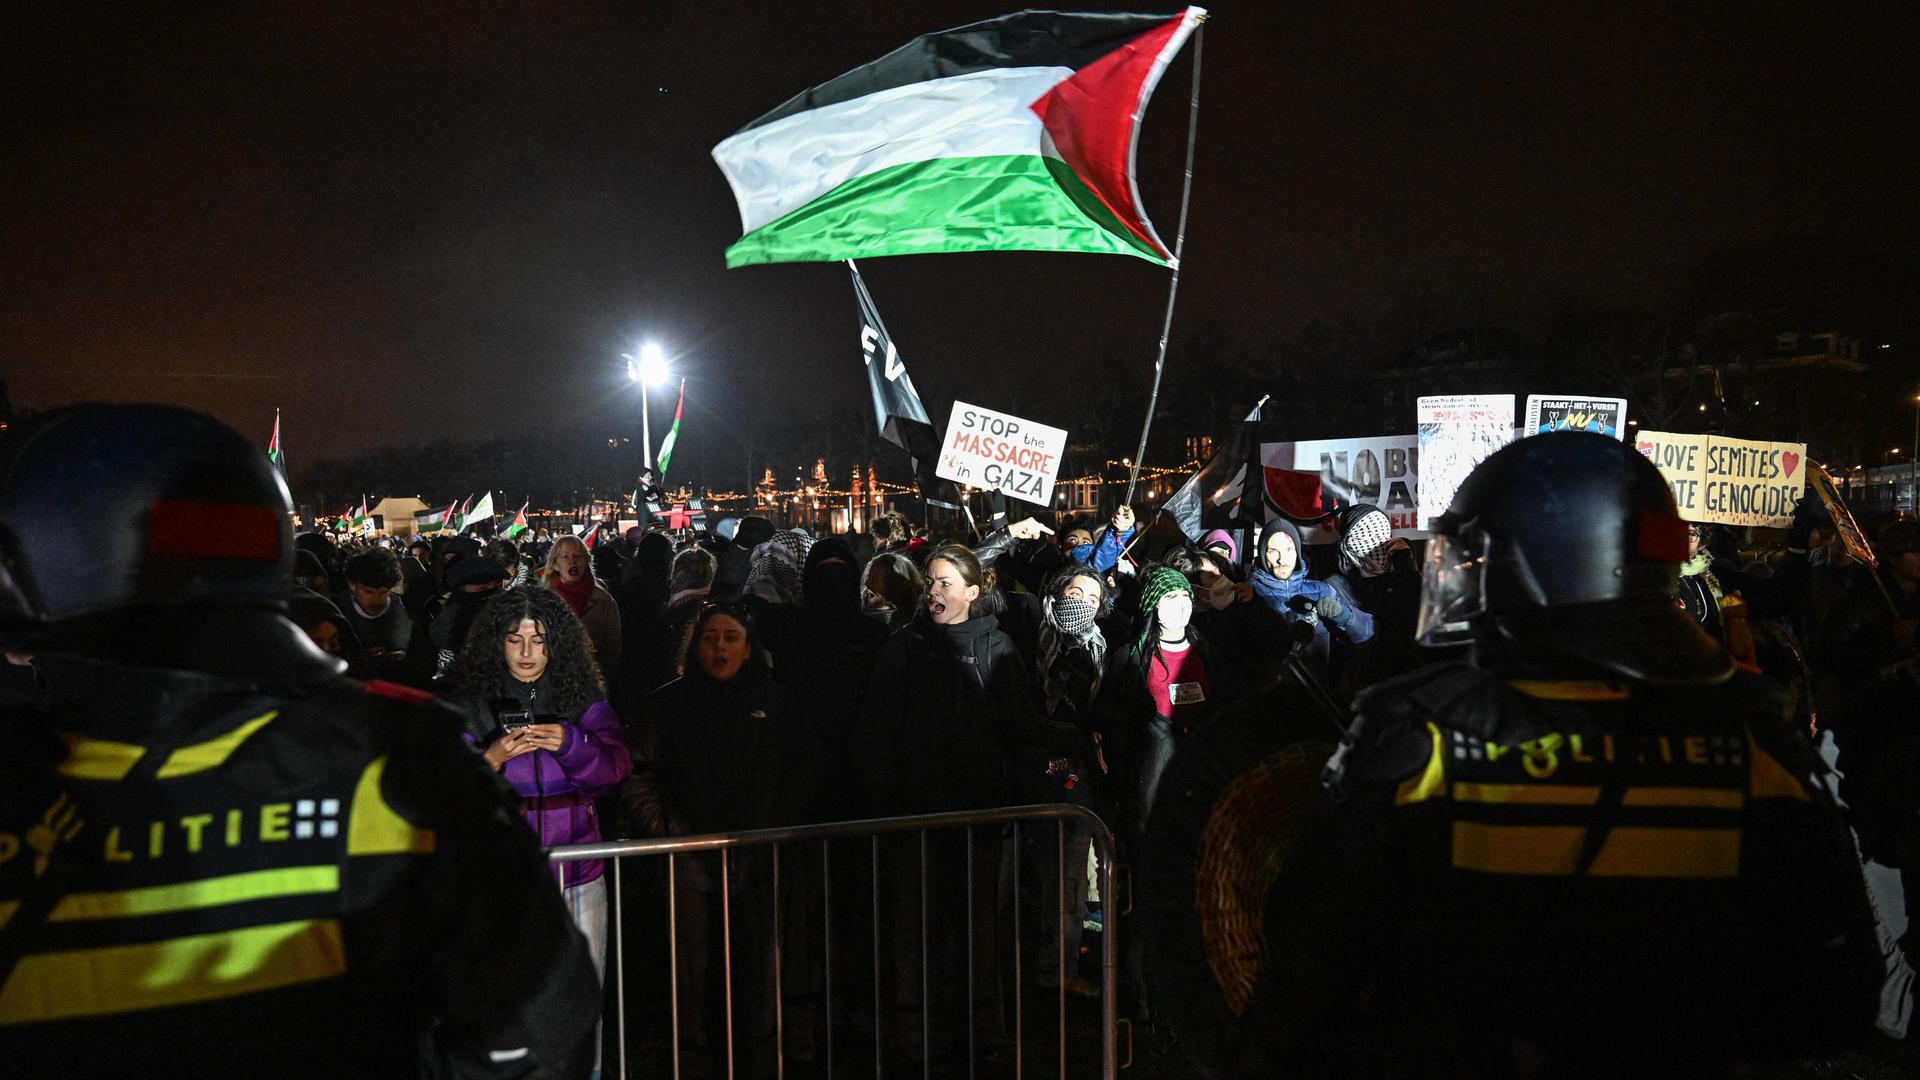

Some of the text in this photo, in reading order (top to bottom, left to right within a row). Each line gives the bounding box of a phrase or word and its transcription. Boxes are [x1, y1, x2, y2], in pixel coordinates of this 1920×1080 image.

[961, 411, 1045, 448] STOP the
[1529, 399, 1538, 436] OCIALISTEN
[1558, 411, 1597, 429] NU
[952, 431, 1055, 475] MASSACRE
[1654, 443, 1698, 472] LOVE
[957, 461, 1043, 498] in GAZA
[1320, 449, 1381, 512] NO
[1384, 481, 1419, 510] A
[1669, 479, 1698, 509] ATE
[1485, 733, 1708, 778] POLIIE
